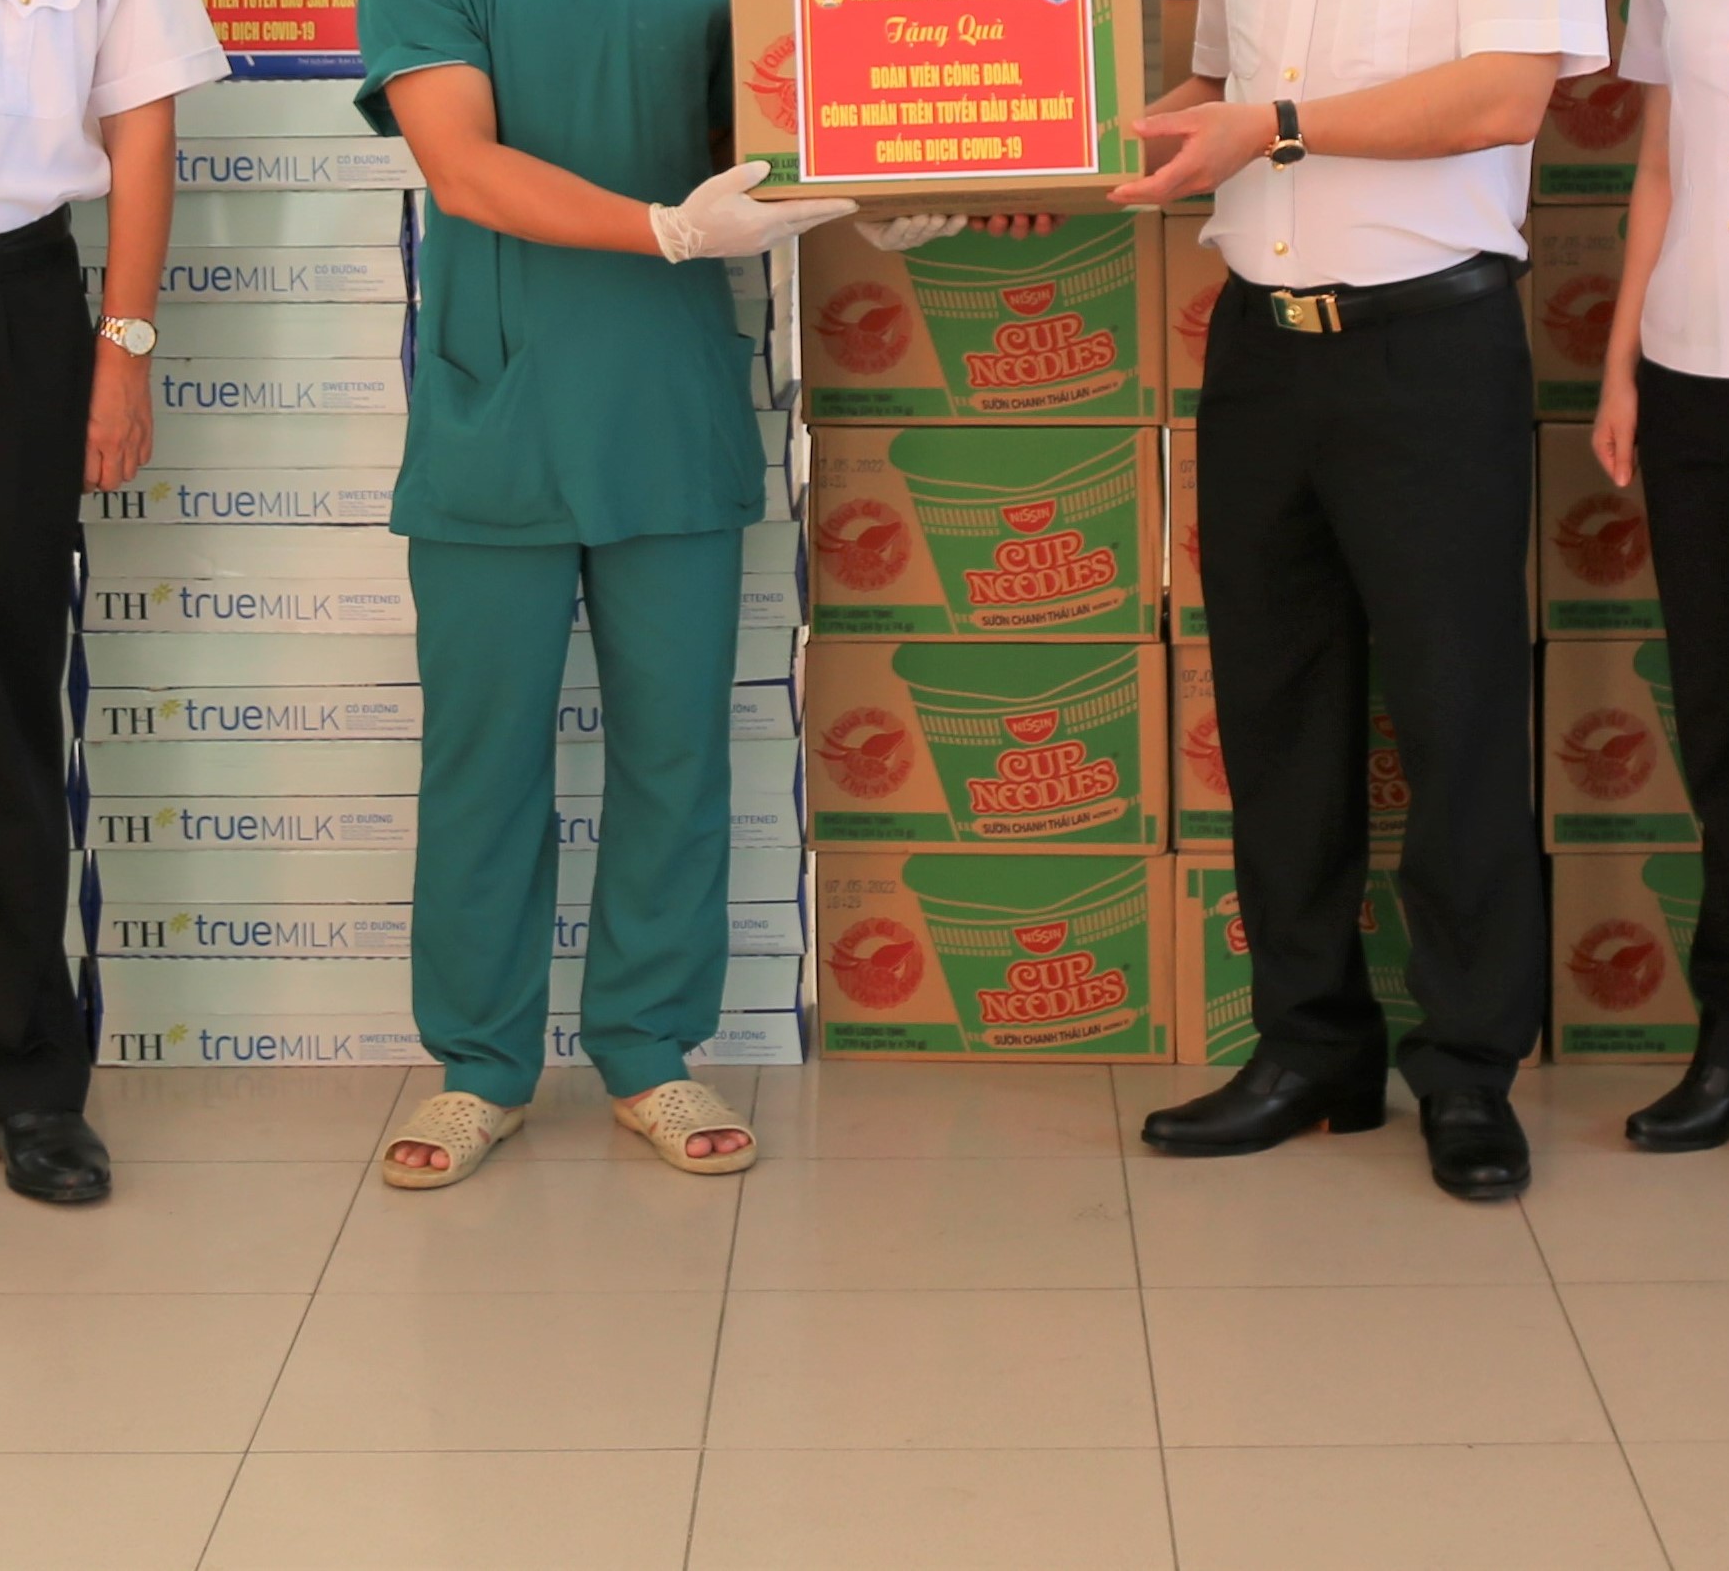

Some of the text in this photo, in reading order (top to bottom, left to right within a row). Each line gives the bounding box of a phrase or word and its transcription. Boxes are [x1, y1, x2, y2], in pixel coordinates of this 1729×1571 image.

[232, 22, 260, 44] DỊCH
[263, 21, 315, 41] COVID-19
[885, 13, 1005, 48] Tặng Quà
[871, 59, 1023, 89] ĐOÀN VIÊN CÔNG ĐOÀN,
[821, 101, 858, 127] CÔNG
[861, 100, 897, 126] NHÂN
[900, 99, 933, 124] TRÊN
[936, 94, 978, 123] TUYẾN
[981, 93, 1007, 122] ĐẦU
[1011, 94, 1038, 121] SẢN
[1040, 91, 1074, 120] XUẤT
[876, 133, 1023, 165] CHỐNG DỊCH COVID-19
[1009, 288, 1051, 307] NISSIN
[999, 315, 1080, 355] CUP
[967, 335, 1114, 385] NOODLES
[162, 375, 315, 408] trueMILK
[322, 382, 385, 391] SWEETENED
[1011, 394, 1046, 409] CHANH
[1047, 390, 1069, 405] THÁI
[1070, 387, 1090, 402] LAN
[93, 485, 332, 519] TH trueMILK
[338, 490, 393, 500] SWEETENE
[1009, 507, 1052, 524] NISSIN
[999, 532, 1080, 571] CUP
[967, 550, 1114, 602] NOODLES
[96, 587, 333, 620] TH trueMILK
[338, 595, 400, 604] SWEETENED
[741, 593, 783, 603] ETENED
[1011, 611, 1047, 626] CHANH
[1048, 606, 1069, 622] THÁI
[1071, 604, 1090, 618] LAN
[103, 699, 339, 735] TH trueMILK
[1012, 717, 1054, 734] NISSIN
[1000, 742, 1083, 780] CUP
[969, 760, 1116, 812] NOODLES
[98, 809, 335, 843] TH trueMILK
[731, 816, 778, 824] EETENED
[1013, 822, 1047, 834] CHANH
[1048, 816, 1070, 830] THÁI
[1072, 813, 1091, 826] LAN
[113, 915, 348, 948] TH trueMILK
[1021, 930, 1063, 947] NISSIN
[1009, 952, 1092, 991] CUP
[979, 971, 1126, 1023] NOODLES
[111, 1030, 352, 1061] TH trueMILK
[1024, 1031, 1057, 1045] CHANH
[1058, 1028, 1080, 1042] THÁI
[1082, 1025, 1101, 1038] LAN
